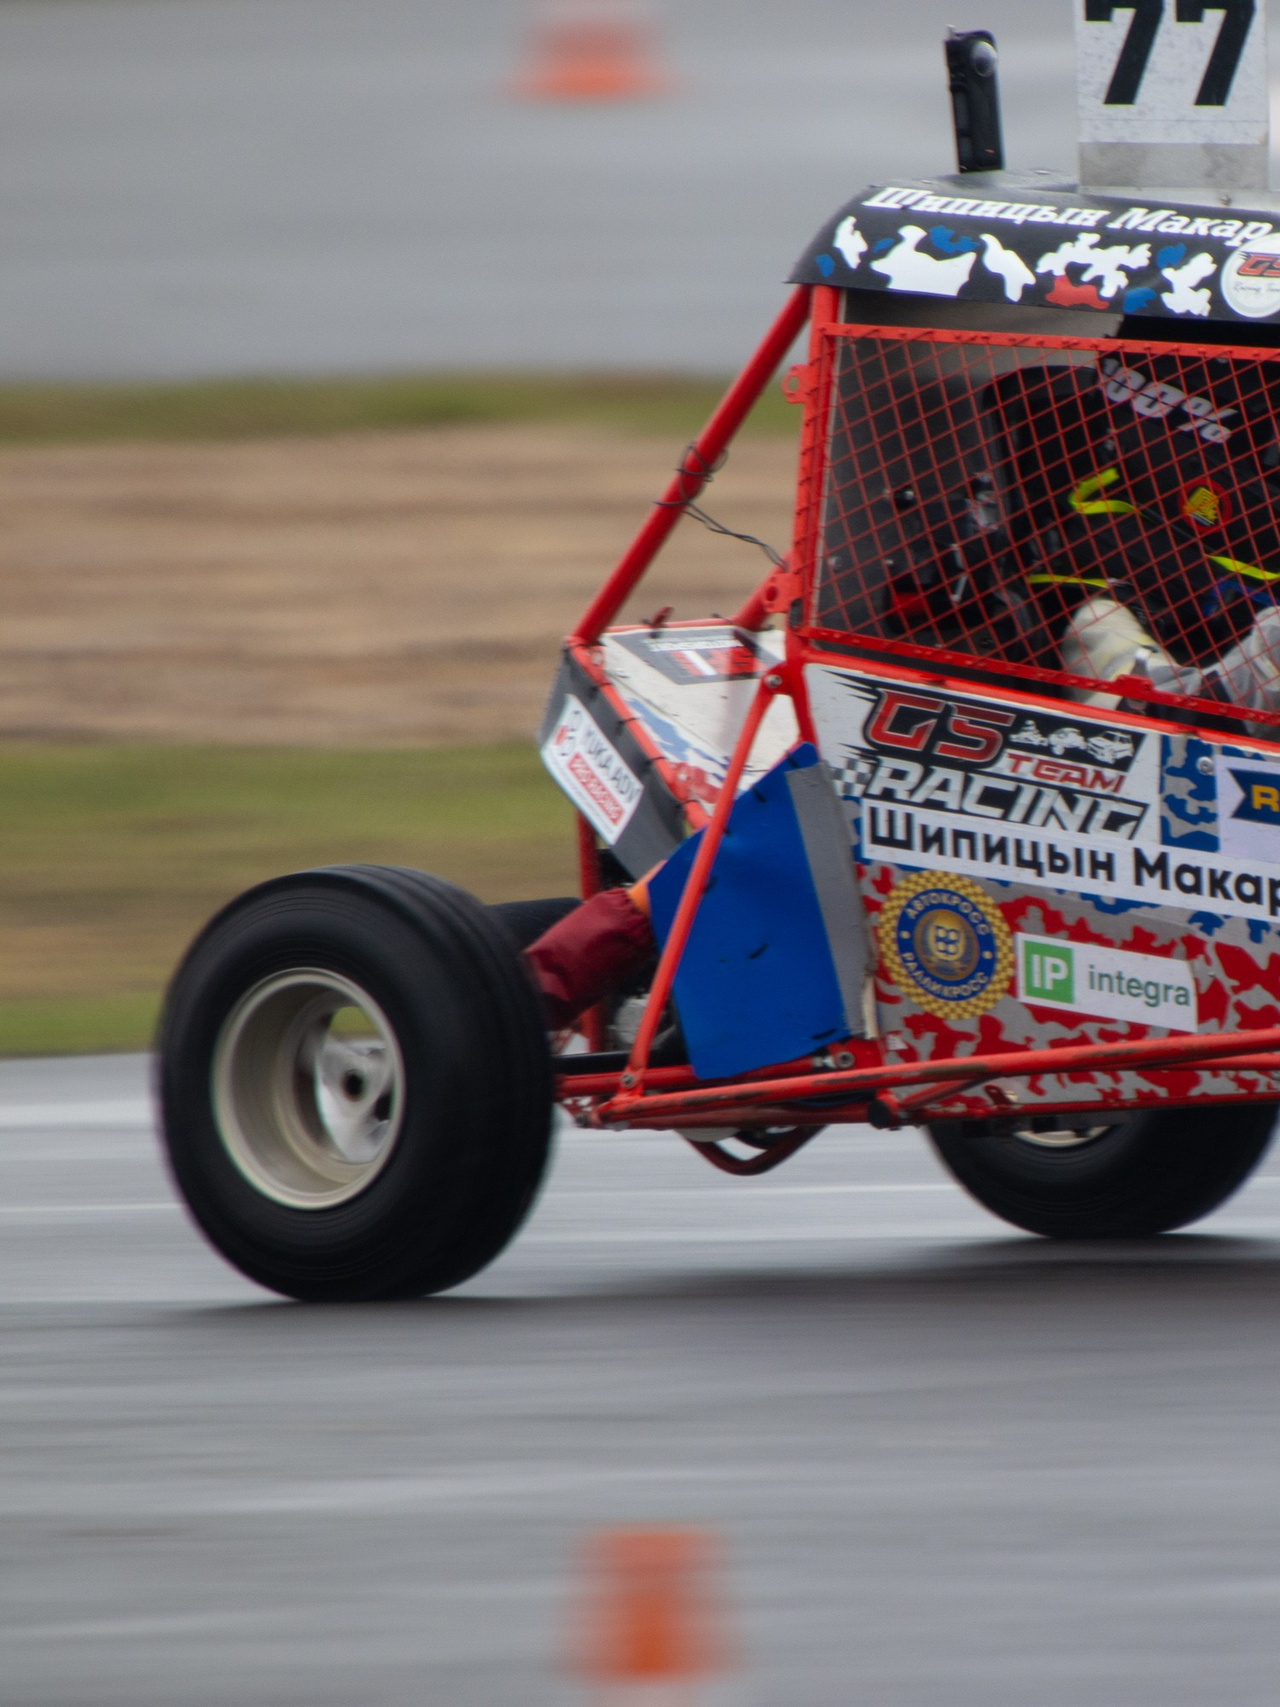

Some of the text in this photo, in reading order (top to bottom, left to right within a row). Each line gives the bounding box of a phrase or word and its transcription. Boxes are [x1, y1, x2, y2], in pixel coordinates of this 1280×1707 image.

[1084, 0, 1257, 106] 77
[862, 187, 1273, 247] Шипицын Макар
[867, 688, 1018, 763] GS
[866, 755, 1150, 840] RACING
[1005, 751, 1129, 794] TEAM
[868, 806, 1116, 883] Шипицын
[905, 892, 990, 936] АВТОКРОСС
[1029, 953, 1192, 1009] IP integra
